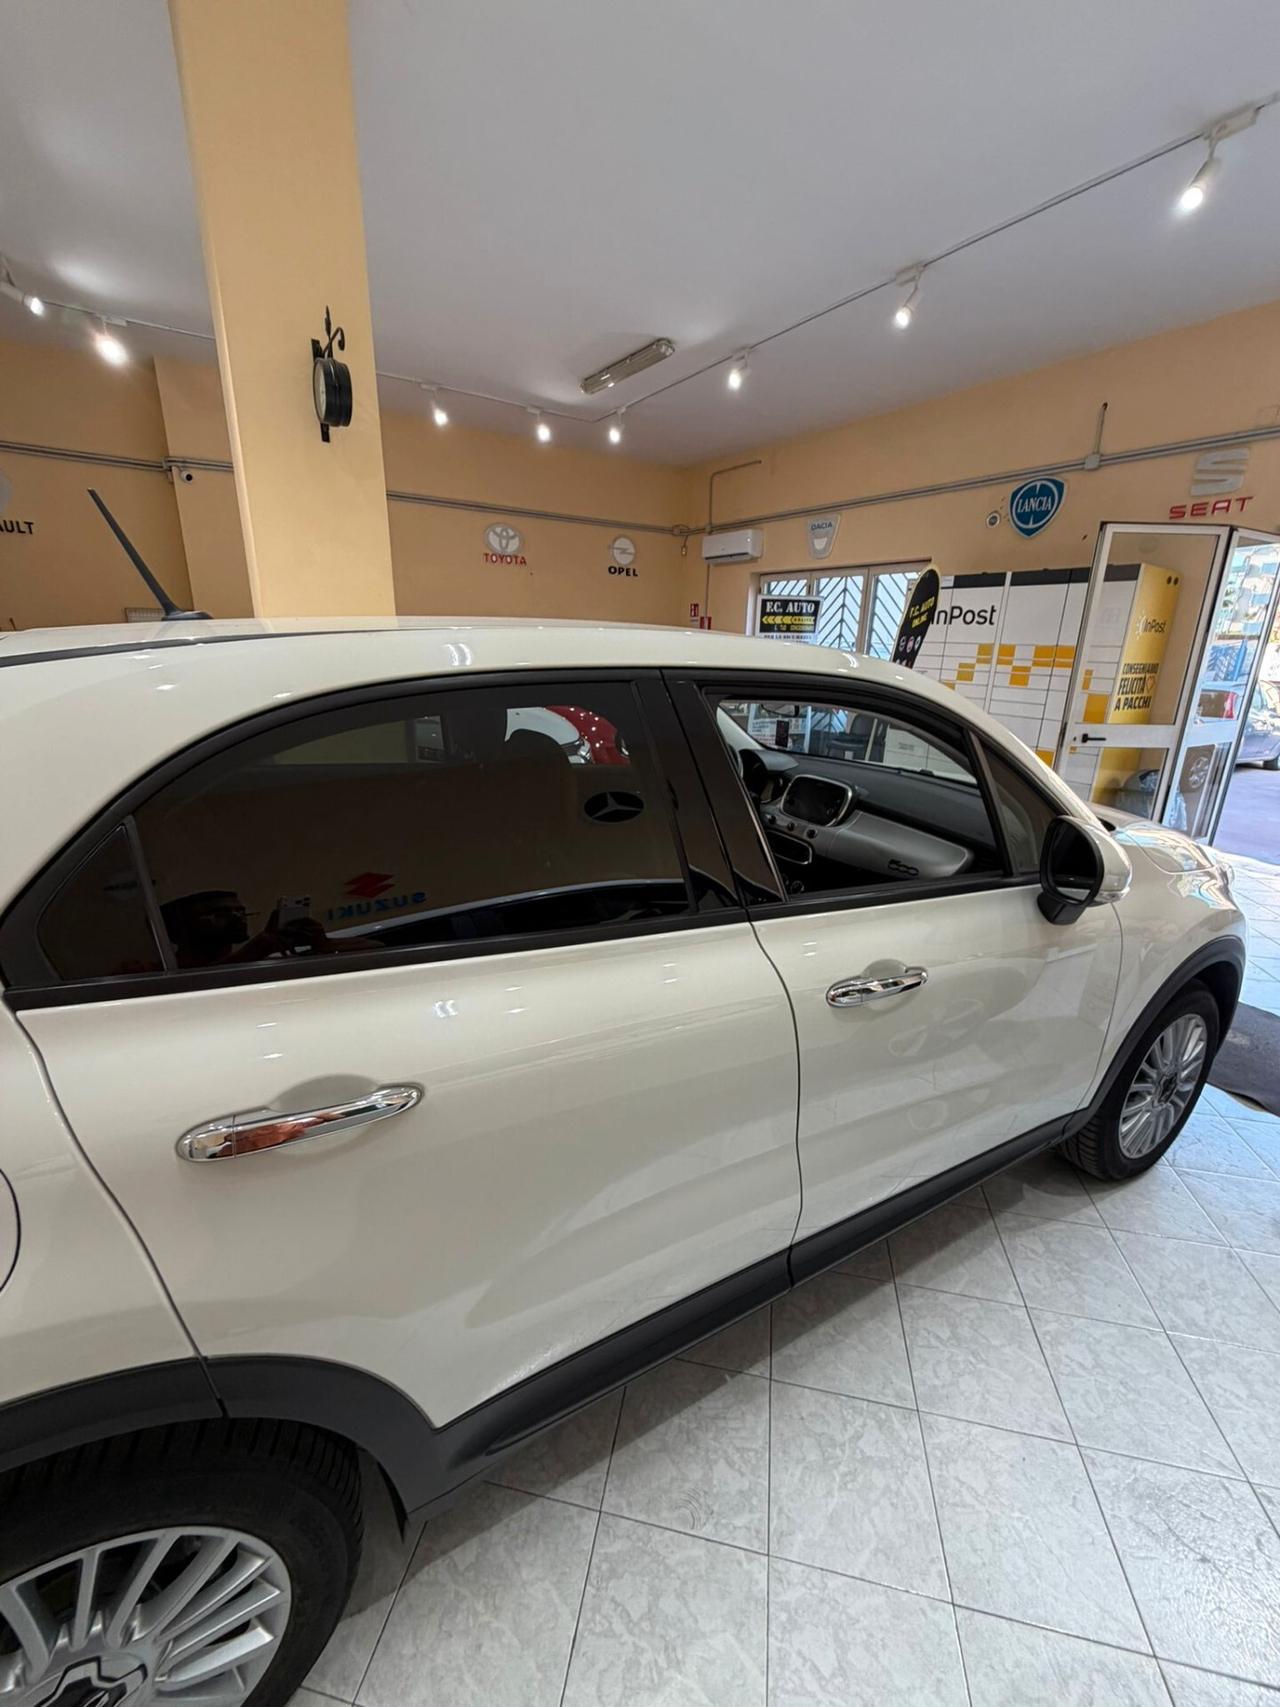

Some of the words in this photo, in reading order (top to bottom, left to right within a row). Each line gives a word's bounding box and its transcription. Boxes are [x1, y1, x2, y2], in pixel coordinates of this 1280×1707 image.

[1017, 495, 1052, 513] LANCIA
[1169, 495, 1254, 520] SEAT
[811, 520, 833, 531] DACIA
[483, 552, 527, 566] TOYOTA
[608, 566, 639, 577] OPEL
[766, 601, 783, 613] F.C.
[786, 601, 815, 613] AUTO
[1144, 618, 1167, 633] InPost
[1117, 674, 1146, 695] FELICITÀ
[1114, 697, 1121, 711] A
[1122, 695, 1152, 710] PACCHI
